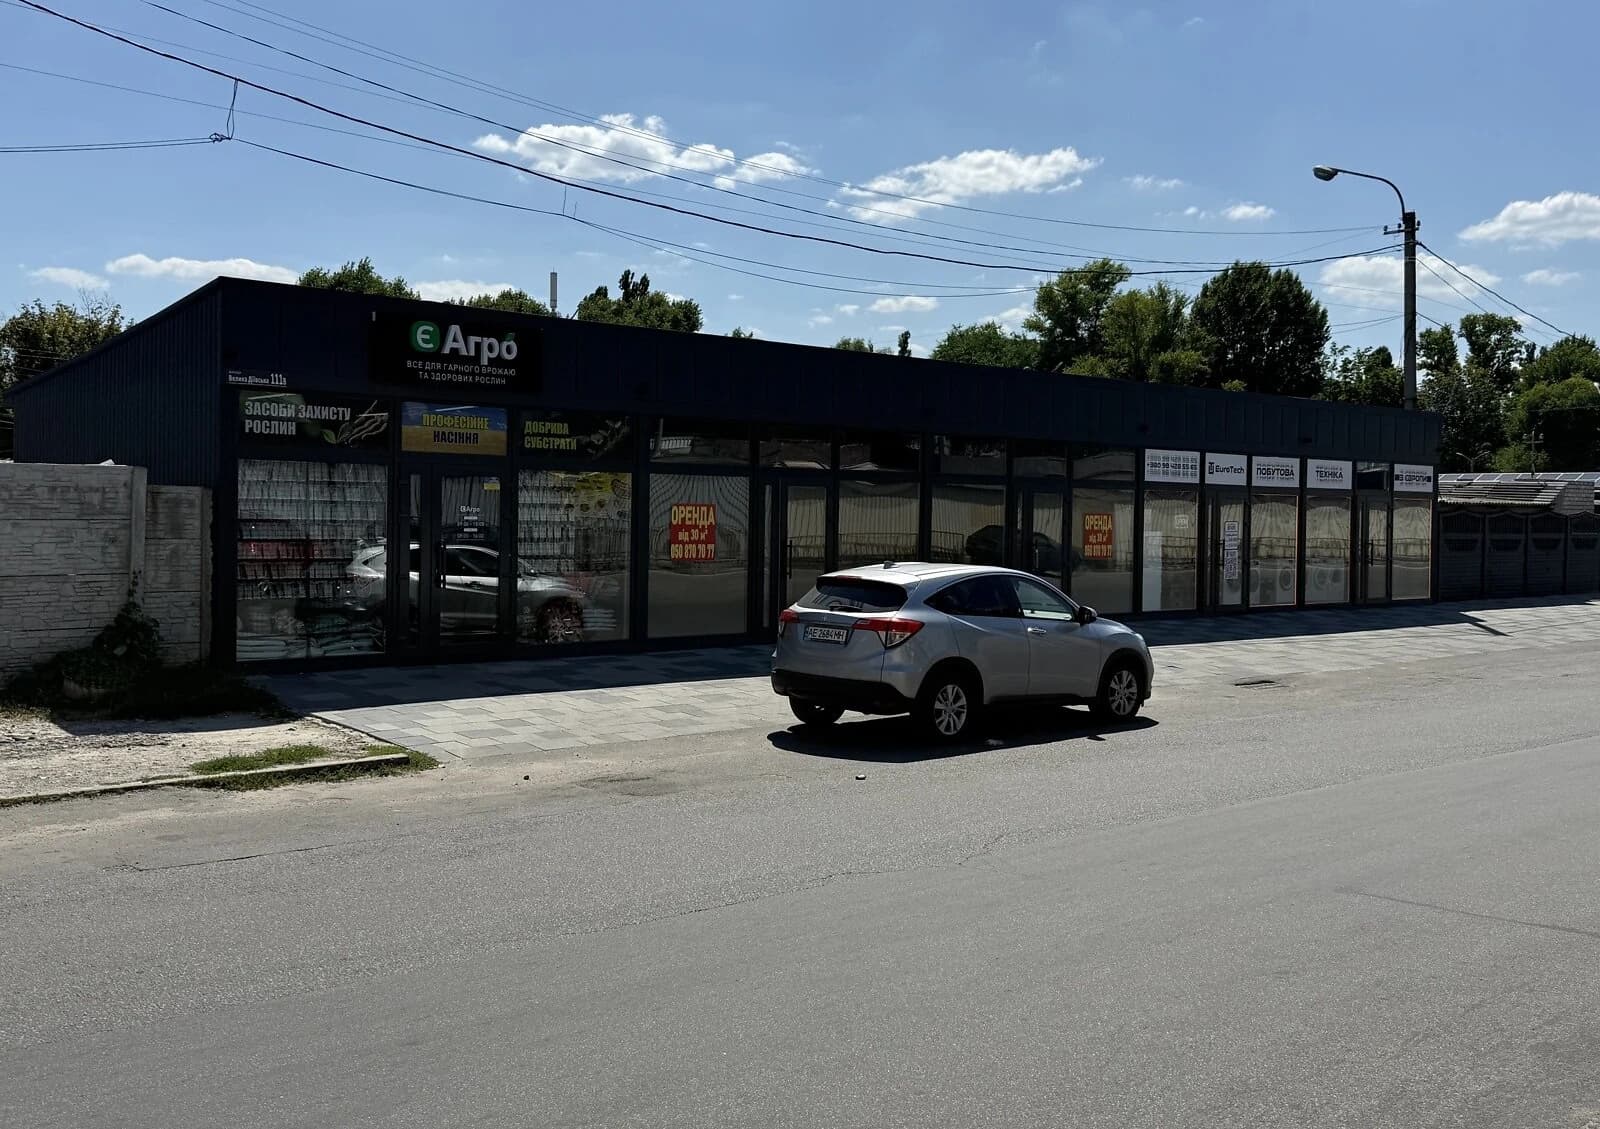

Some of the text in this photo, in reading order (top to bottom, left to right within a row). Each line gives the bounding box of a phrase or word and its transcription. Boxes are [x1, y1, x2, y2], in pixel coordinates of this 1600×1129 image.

[441, 324, 518, 365] Агро
[406, 360, 516, 377] ВСЕ ДЛЯ ГАРНОГО ВРОЖАЮ
[418, 371, 506, 385] ТА ЗДОРОВИХ РОСЛИН
[244, 401, 351, 421] ЗАСОБИ ЗАХИСТУ
[244, 419, 297, 436] РОСЛИН
[422, 413, 489, 430] ПРОФЕСІЙНЕ
[524, 420, 569, 435] ДОБРИВА
[433, 430, 479, 445] НАСІННЯ
[524, 435, 577, 450] СУБСТРАТИ
[1215, 464, 1244, 474] EuroTech
[1256, 467, 1295, 477] ПОБУТОВА
[1315, 469, 1344, 479] ТЕХНІКА
[671, 505, 715, 528] ОРЕНДА
[1084, 514, 1113, 532] ОРЕНДА
[678, 528, 689, 542] від
[690, 528, 699, 541] 30
[671, 543, 715, 559] 050 870 70 77
[808, 628, 818, 638] AE
